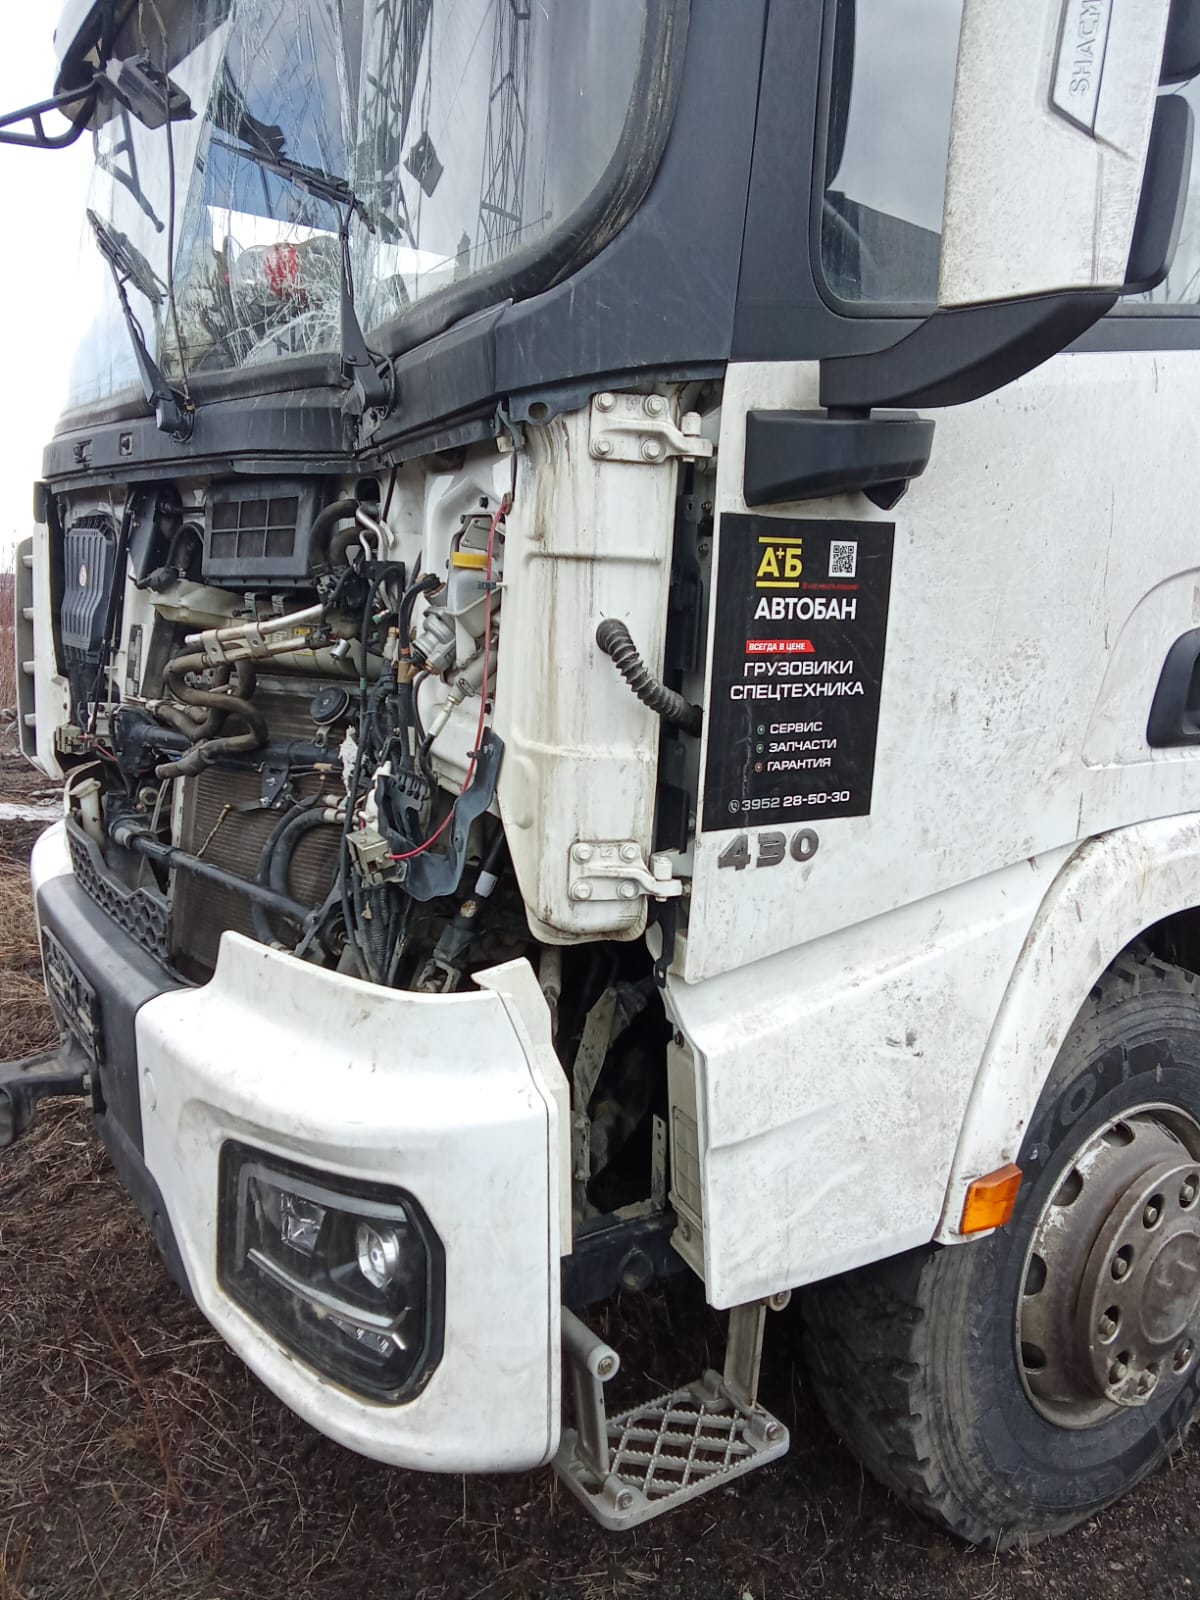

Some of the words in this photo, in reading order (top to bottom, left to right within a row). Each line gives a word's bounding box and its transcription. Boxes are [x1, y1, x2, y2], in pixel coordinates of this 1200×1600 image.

[754, 597, 857, 621] АВТОБАН
[749, 642, 777, 652] ВСЕГДА
[779, 642, 785, 651] В
[786, 642, 806, 653] ЦЕНЕ
[744, 660, 853, 677] ГРУЗОВИКИ
[730, 681, 865, 701] СПЕЦТЕХНИКА
[769, 721, 823, 735] СЕРВИС
[768, 739, 837, 753] ЗАПЧАСТИ
[767, 757, 832, 772] ГАРАНТИЯ
[741, 798, 780, 811] 3952
[783, 790, 850, 807] 28-50-30
[718, 827, 820, 871] 430
